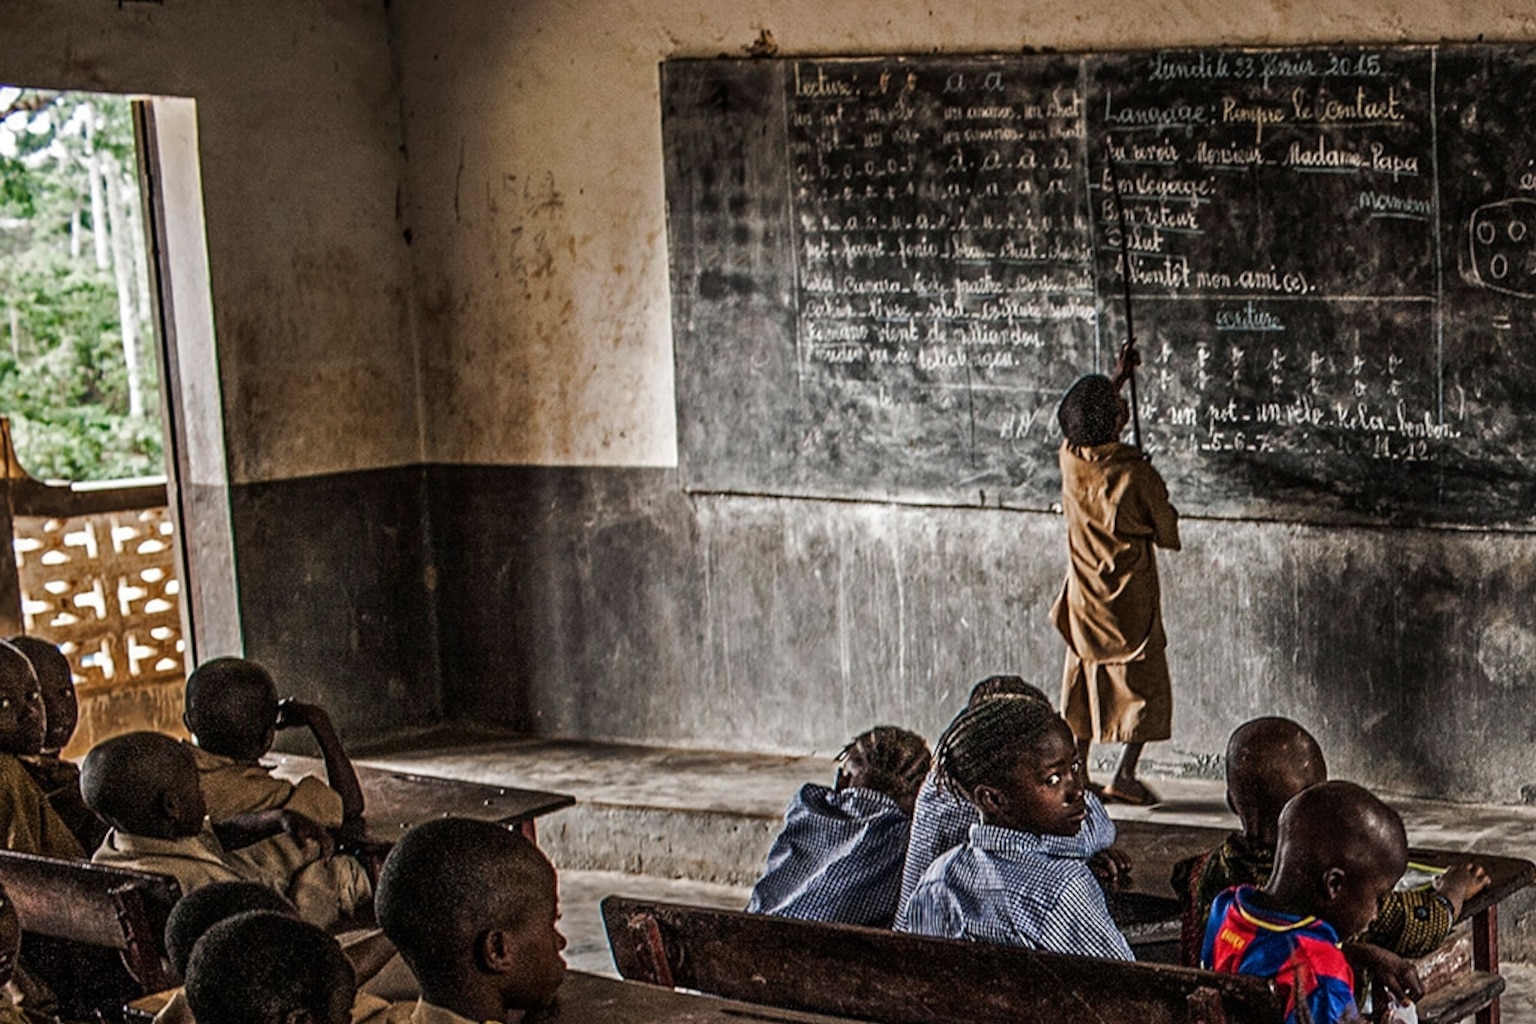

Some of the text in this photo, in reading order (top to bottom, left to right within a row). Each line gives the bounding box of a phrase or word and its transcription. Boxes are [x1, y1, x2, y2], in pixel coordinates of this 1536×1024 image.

[1233, 56, 1256, 79] 23
[1324, 53, 1382, 77] 2015
[1104, 226, 1165, 252] Slut
